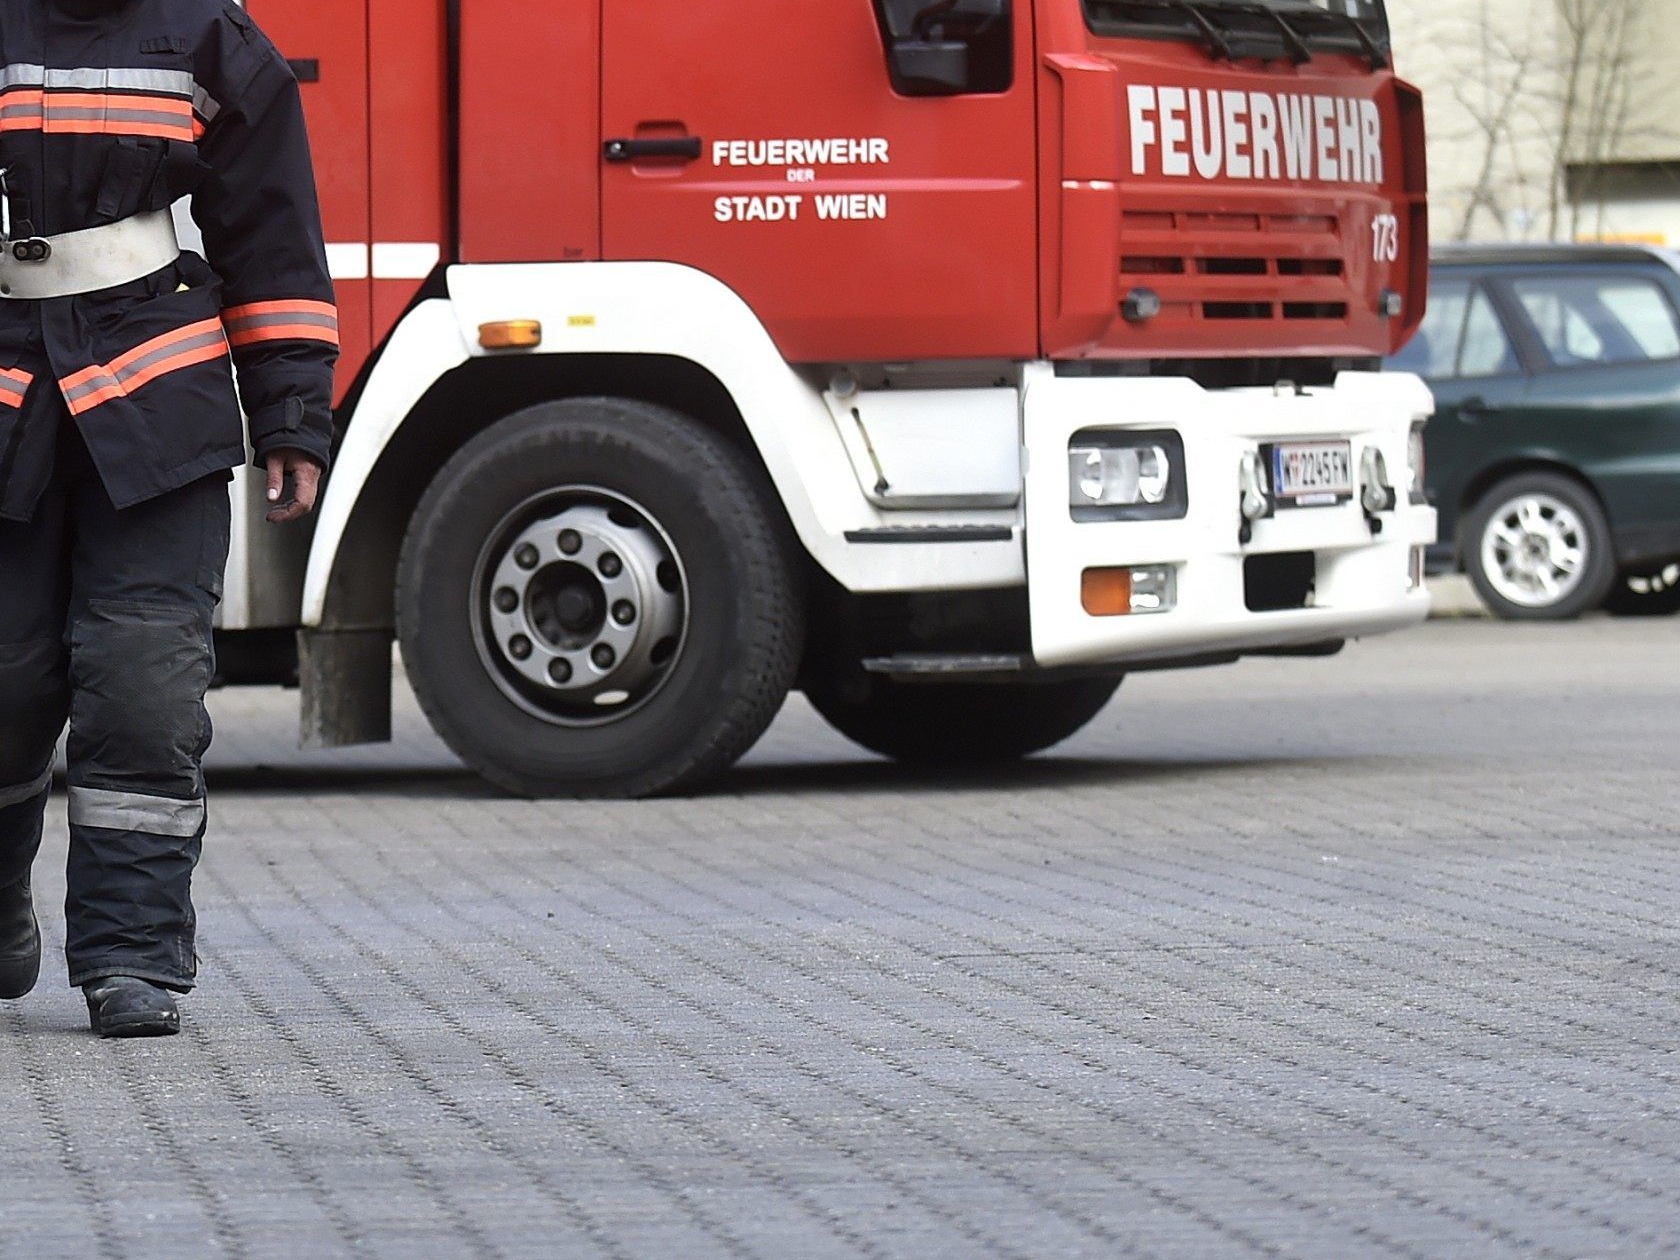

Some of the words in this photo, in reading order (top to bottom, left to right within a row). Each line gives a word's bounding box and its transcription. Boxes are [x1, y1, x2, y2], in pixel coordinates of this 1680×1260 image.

[1127, 85, 1383, 183] FEUERWEHR
[713, 138, 889, 166] FEUERWEHR
[787, 168, 814, 182] DER
[714, 195, 802, 222] STADT
[815, 193, 886, 220] WIEN
[1371, 214, 1397, 261] 173
